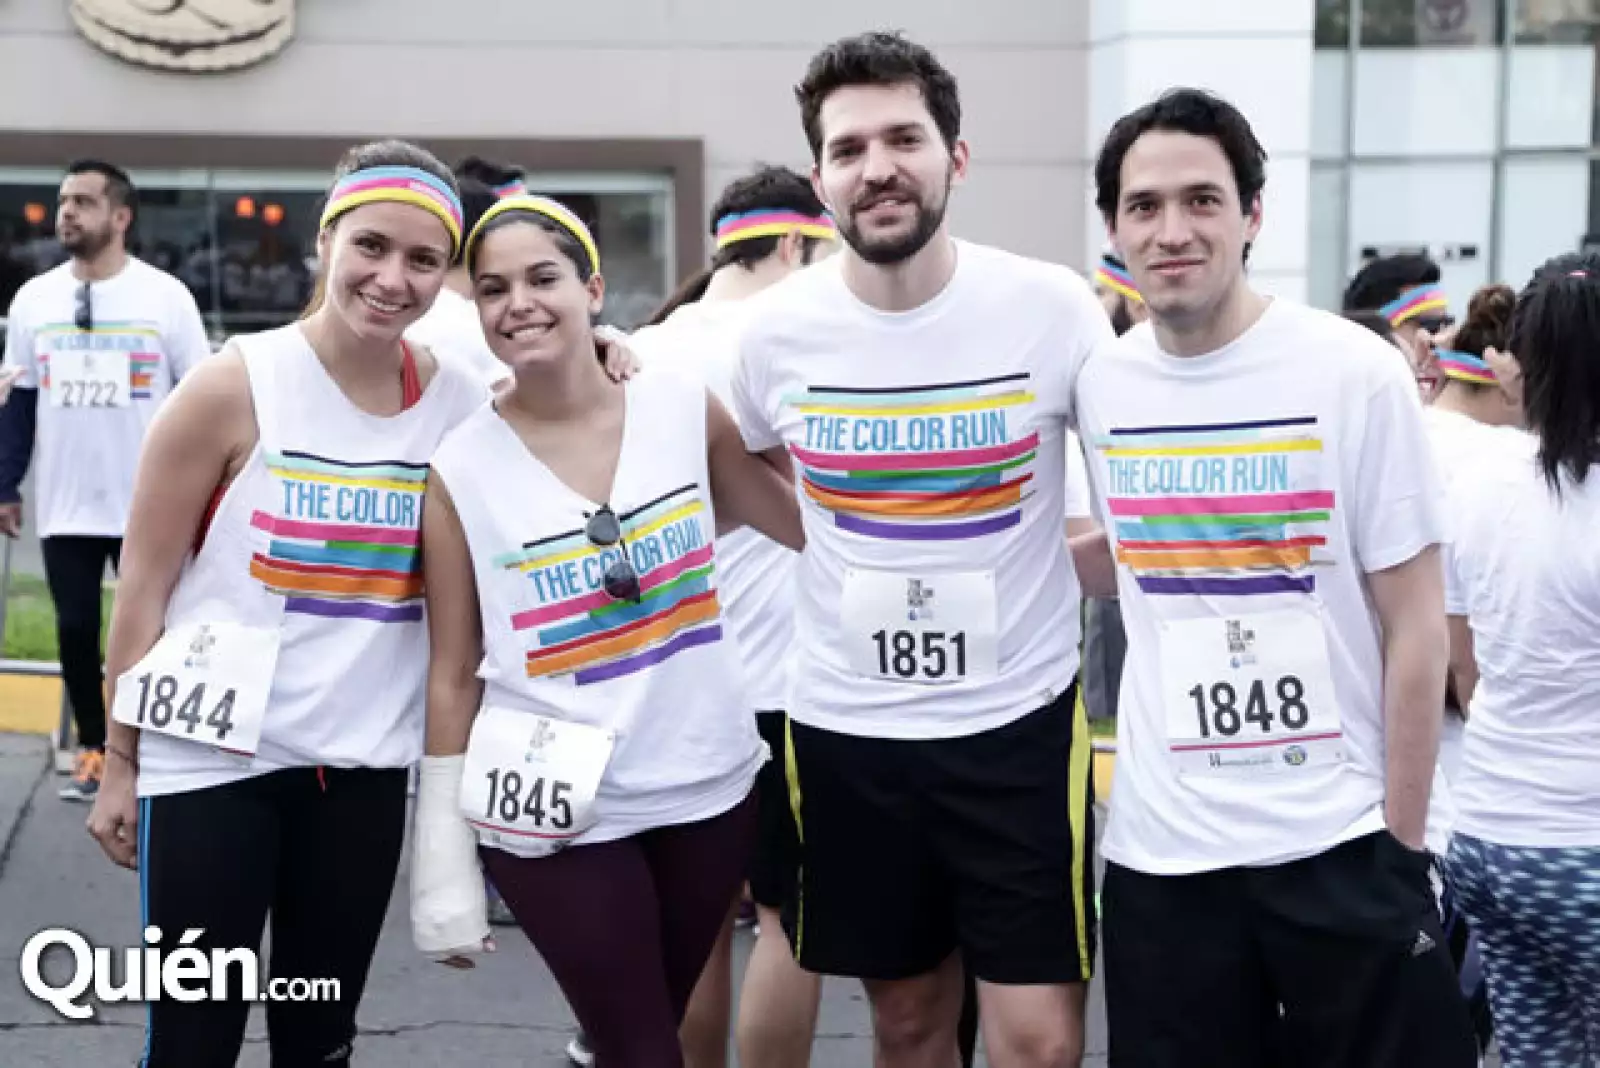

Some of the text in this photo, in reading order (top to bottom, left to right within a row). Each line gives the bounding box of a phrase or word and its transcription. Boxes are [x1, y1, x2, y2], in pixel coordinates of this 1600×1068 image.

[60, 380, 118, 408] 2722
[804, 409, 1007, 451] THE COLOR RUN
[1107, 454, 1289, 493] THE COLOR RUN
[282, 480, 415, 526] THE COLOR
[527, 561, 583, 603] THE
[581, 535, 664, 590] COOR
[872, 629, 966, 679] 1851
[137, 672, 238, 741] 1844
[1188, 674, 1309, 738] 1848
[485, 767, 574, 829] 1845
